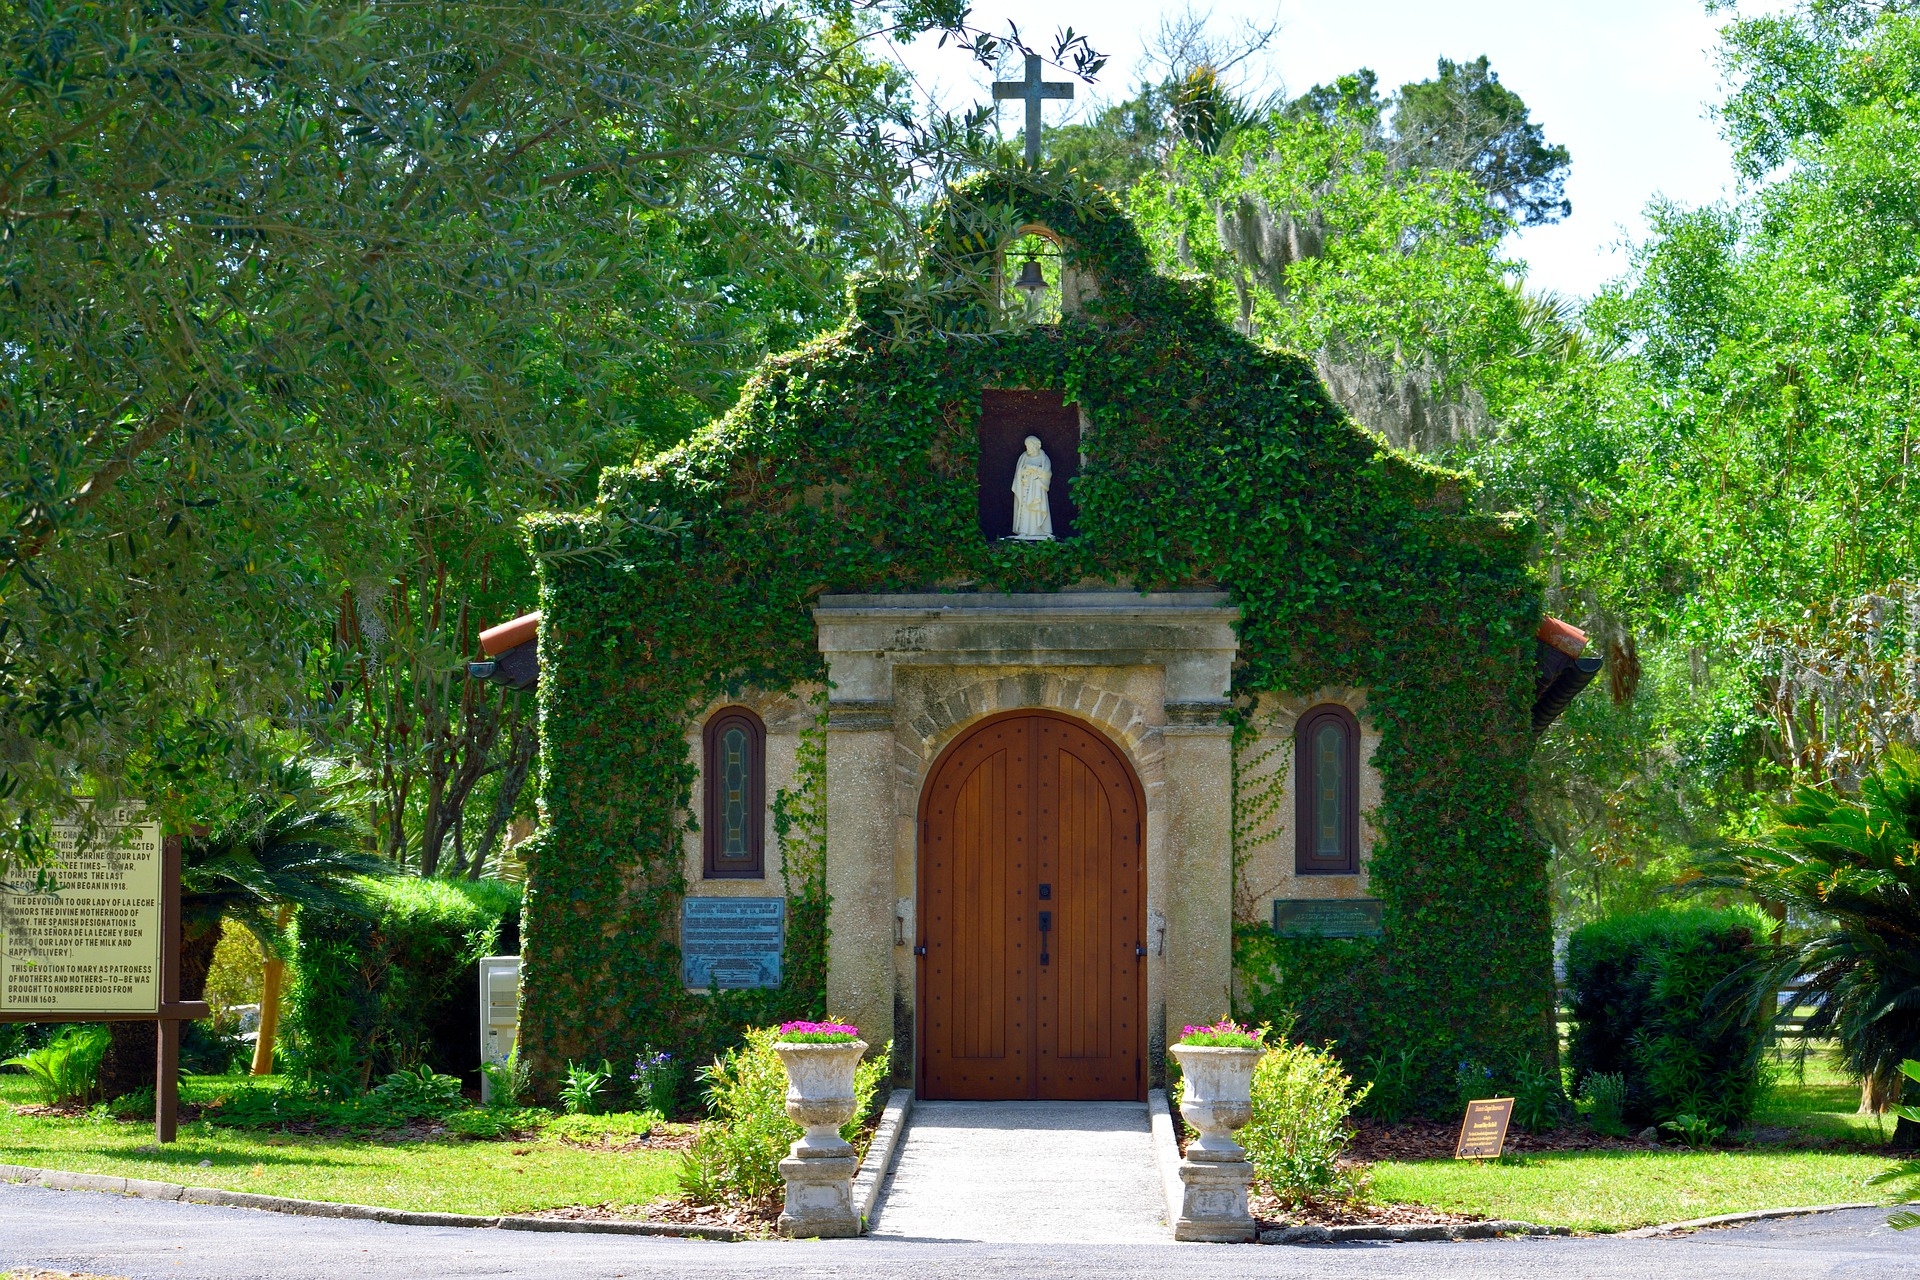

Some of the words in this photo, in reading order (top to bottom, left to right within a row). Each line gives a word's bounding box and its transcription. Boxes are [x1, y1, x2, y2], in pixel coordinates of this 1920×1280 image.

[57, 841, 72, 849] THIS
[123, 842, 155, 851] ECTED
[62, 852, 80, 860] THIS
[79, 852, 105, 860] SHRINE
[117, 852, 131, 860] OUR
[133, 853, 151, 861] LADY
[92, 872, 104, 880] THE
[106, 872, 124, 880] LAST
[11, 881, 76, 889] RECONTION
[77, 882, 101, 890] BEGAN
[102, 882, 109, 890] IN
[111, 883, 128, 891] 1918.
[13, 897, 26, 905] THE
[65, 898, 75, 906] TO
[76, 898, 91, 906] OUR
[92, 898, 111, 906] LADY
[112, 898, 121, 906] OF
[122, 899, 131, 907] LA
[132, 899, 155, 907] LECHE
[41, 908, 54, 916] THE
[55, 908, 79, 916] DIVINE
[80, 908, 129, 917] MOTHERHOOD
[130, 909, 139, 917] OF
[9, 917, 32, 926] RY.
[33, 918, 47, 926] THE
[48, 918, 79, 927] SPANISH
[80, 918, 128, 927] DESIGNATION
[129, 919, 137, 927] IS
[9, 928, 42, 936] NTRA
[44, 926, 74, 936] SEÑORA
[74, 928, 84, 937] DE
[84, 928, 93, 937] LA
[94, 928, 116, 937] LECHE
[118, 929, 122, 937] Y
[124, 929, 143, 937] BUEN
[54, 938, 73, 947] LADY
[74, 939, 84, 947] OF
[85, 939, 98, 947] THE
[99, 939, 117, 947] MILK
[118, 939, 132, 947] AND
[9, 948, 32, 956] HAPPY
[11, 965, 28, 973] THIS
[28, 965, 65, 973] DEVOTION
[66, 965, 76, 973] TO
[77, 965, 97, 973] MARY
[99, 965, 108, 973] AS
[109, 965, 152, 974] PATRONESS
[8, 975, 18, 983] OF
[19, 975, 53, 983] MOTHERS
[54, 975, 68, 983] AND
[134, 976, 150, 984] WAS
[8, 985, 42, 993] BROUGHT
[44, 985, 53, 993] TO
[54, 985, 84, 993] NOMBRE
[95, 986, 112, 994] DIOS
[113, 986, 133, 994] FROM
[8, 995, 30, 1003] SPAIN
[31, 995, 38, 1003] IN
[40, 995, 58, 1004] 1603.
